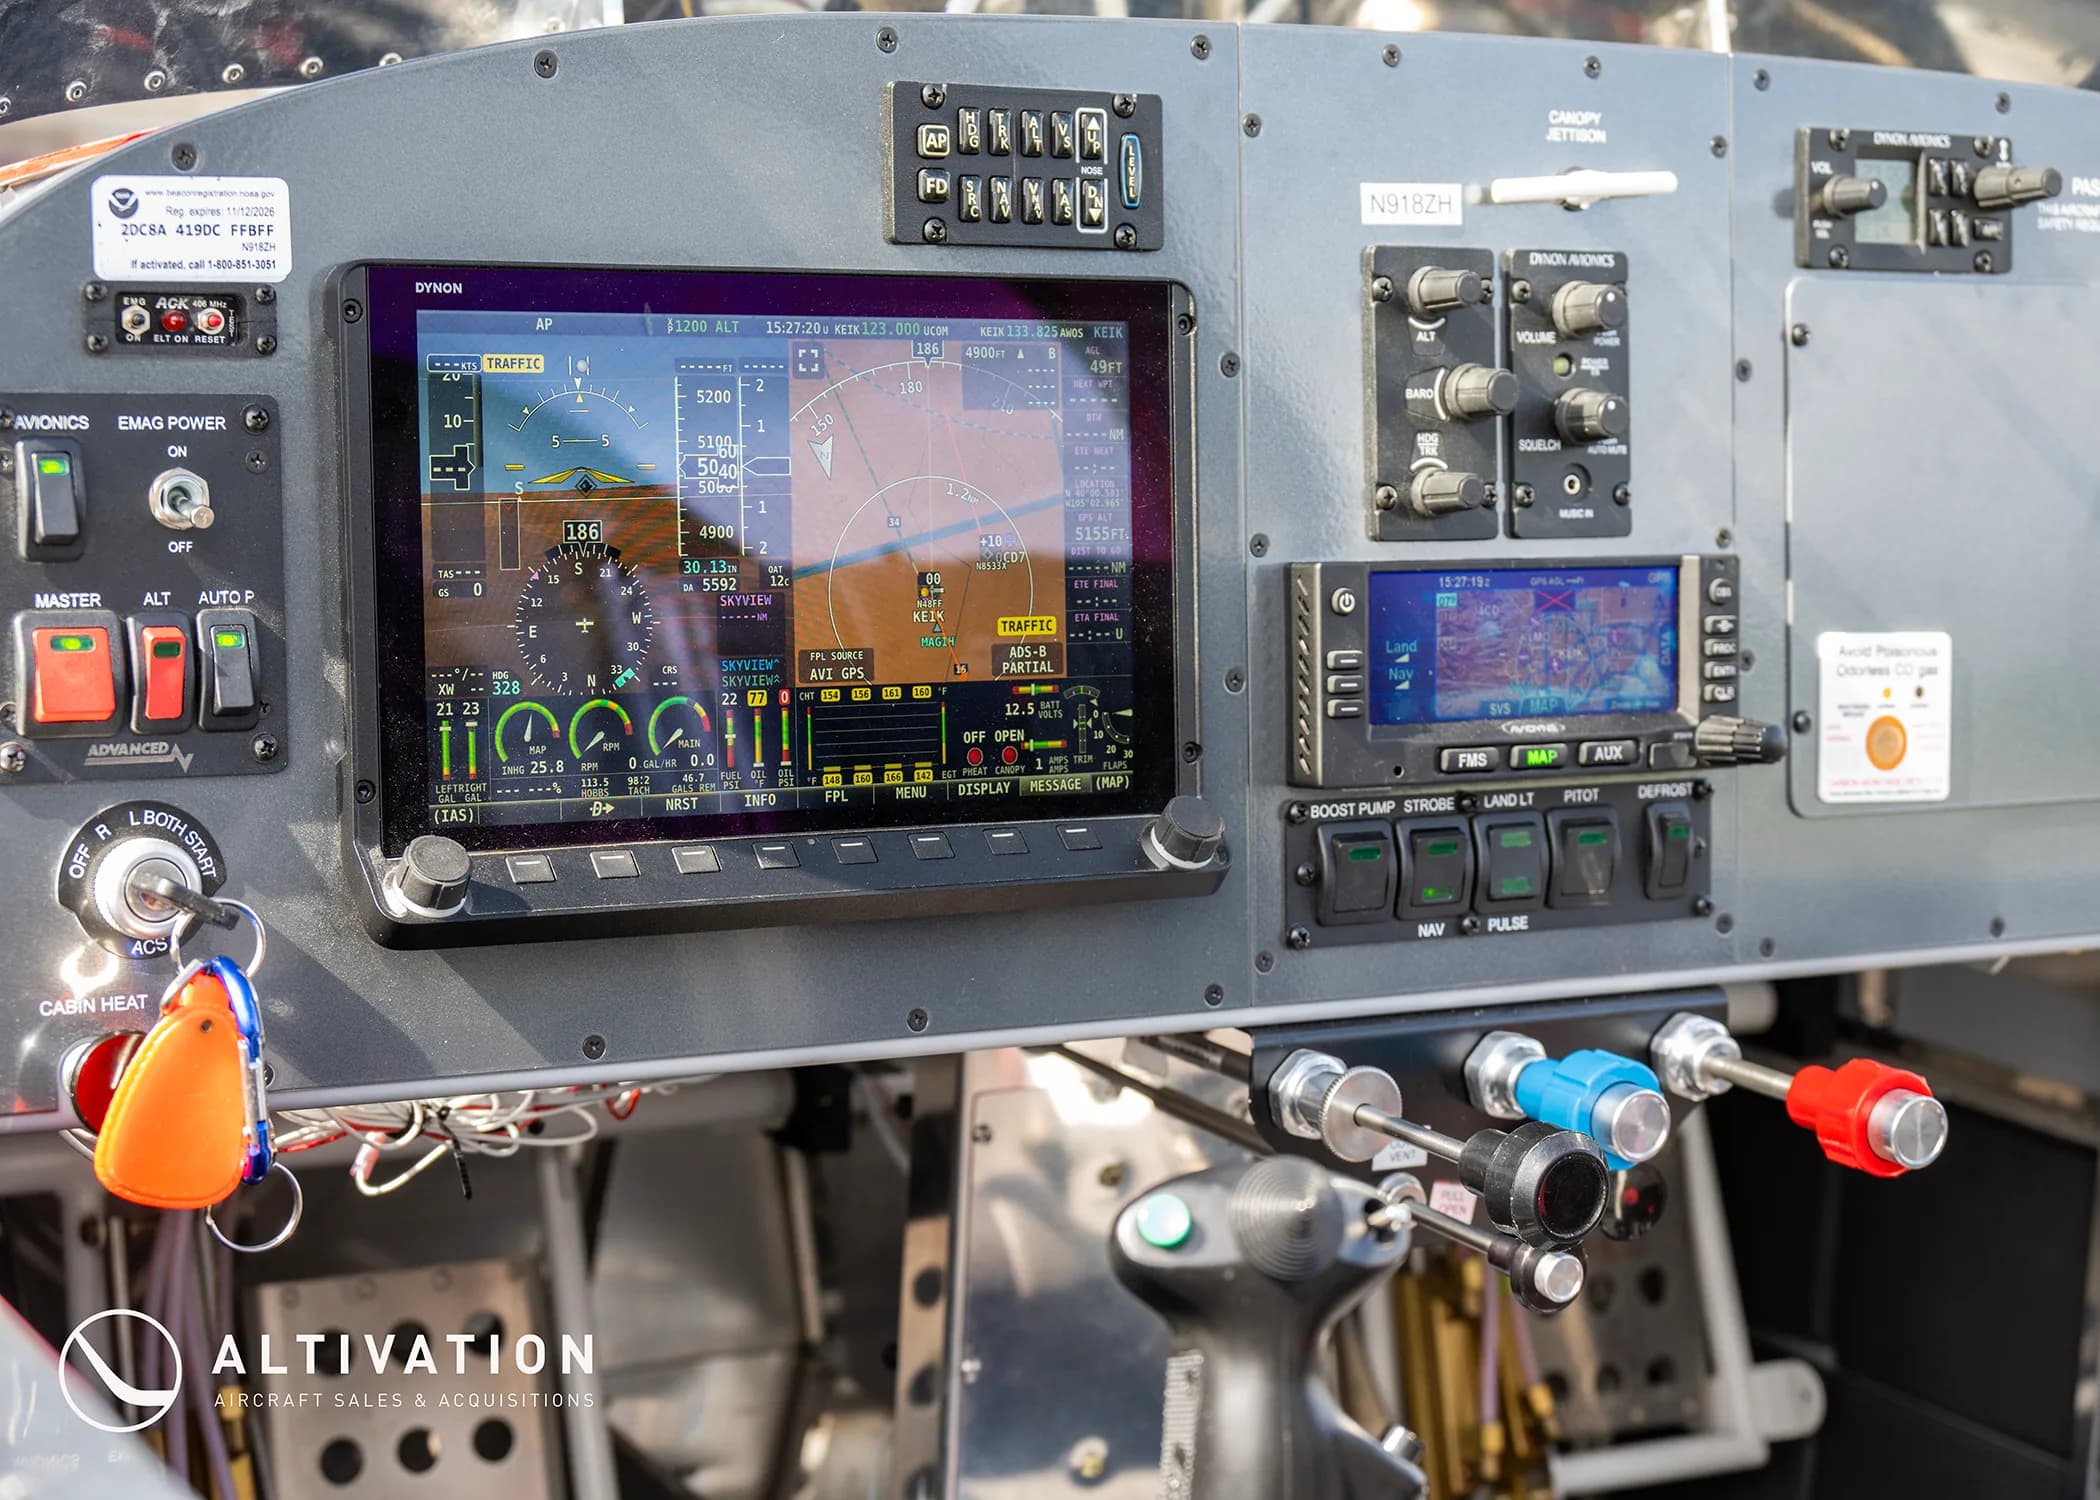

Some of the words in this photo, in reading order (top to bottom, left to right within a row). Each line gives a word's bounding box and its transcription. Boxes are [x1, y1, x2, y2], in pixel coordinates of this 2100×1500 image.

[1548, 109, 1602, 126] CANOPY
[965, 112, 979, 149] HDG
[996, 112, 1010, 150] TRK
[1030, 116, 1043, 152] ALT
[1545, 126, 1607, 144] JETTISON
[925, 135, 947, 149] AP
[1081, 165, 1104, 176] NOSE
[1127, 144, 1137, 199] LEVEL
[926, 180, 948, 194] FD
[966, 180, 980, 218] SRC
[997, 182, 1012, 217] NAV
[1370, 193, 1452, 215] N918ZH
[226, 206, 275, 217] 11/12/2026
[121, 223, 167, 236] 2DC8A
[176, 224, 221, 236] 419DC
[231, 224, 275, 237] FFBFF
[242, 242, 276, 252] N918ZH
[140, 259, 186, 271] activated,
[188, 259, 205, 270] call
[207, 259, 276, 270] 1-800-851-3051
[1529, 252, 1567, 267] DYNON
[1567, 253, 1615, 268] AVIONICS
[415, 282, 463, 294] DYNON
[155, 296, 190, 310] ACK
[675, 319, 708, 333] 1200
[715, 320, 740, 333] ALT
[861, 321, 920, 336] 123.000
[980, 326, 1005, 337] KEIK
[1006, 325, 1059, 338] 133.825
[1059, 327, 1084, 338] AWOS
[1094, 326, 1124, 339] KEIK
[153, 334, 171, 343] ELT
[173, 334, 189, 343] ON
[194, 334, 226, 344] RESET
[1416, 331, 1436, 343] ALT
[1516, 331, 1556, 344] VOLUME
[916, 342, 939, 356] 186
[486, 357, 541, 370] TRAFFIC
[899, 380, 923, 395] 180
[1405, 389, 1434, 400] BARO
[696, 389, 731, 404] 5200
[14, 414, 90, 431] AVIONICS
[118, 415, 164, 431] EMAG
[168, 415, 227, 431] POWER
[810, 413, 834, 437] 150
[1417, 433, 1438, 444] HDG
[1518, 439, 1562, 451] SQUELCH
[167, 445, 188, 458] ON
[1419, 445, 1438, 457] TRK
[566, 523, 600, 541] 186
[699, 525, 734, 539] 4900
[168, 541, 194, 553] OFF
[767, 565, 783, 574] OAT
[702, 577, 737, 592] 5592
[1093, 579, 1119, 588] FINAL
[35, 592, 102, 609] MASTER
[143, 591, 171, 606] ALT
[198, 590, 242, 605] AUTO
[244, 589, 255, 604] P
[719, 594, 772, 607] SKYVIEW
[1075, 613, 1090, 622] ETA
[1094, 612, 1120, 622] FINAL
[1001, 619, 1053, 632] TRAFFIC
[1009, 645, 1047, 659] ADS-B
[1385, 639, 1418, 654] Land
[810, 651, 826, 661] FPL
[831, 650, 864, 660] SOURCE
[662, 665, 678, 675] CRS
[809, 668, 833, 681] AVI
[841, 666, 865, 680] GPS
[1002, 660, 1054, 674] PARTIAL
[1388, 667, 1415, 681] Nav
[492, 671, 509, 680] HDG
[492, 680, 521, 696] 328
[799, 691, 816, 701] CHT
[1004, 702, 1035, 717] 12.5
[1040, 701, 1061, 710] BATT
[1488, 702, 1512, 716] SVS
[1529, 699, 1558, 714] MAP
[1037, 709, 1063, 719] VOLTS
[963, 730, 986, 744] OFF
[994, 729, 1025, 742] OPEN
[88, 741, 170, 758] ADVANCED
[528, 745, 547, 755] MAP
[602, 742, 620, 752] RPM
[678, 739, 701, 748] MAIN
[1073, 755, 1094, 764] TRIM
[1458, 752, 1489, 769] FMS
[1526, 749, 1558, 766] MAP
[1594, 745, 1623, 762] AUX
[502, 765, 525, 775] INHG
[530, 760, 565, 774] 25.8
[580, 762, 599, 772] RPM
[643, 758, 678, 769] GAL/HR
[690, 753, 715, 767] 0.0
[1103, 760, 1128, 771] FLAPS
[720, 771, 742, 781] FUEL
[750, 770, 767, 779] OIL
[778, 769, 795, 778] OIL
[941, 770, 957, 779] EGT
[962, 766, 989, 777] PHEAT
[994, 765, 1026, 775] CANOPY
[581, 777, 610, 788] 113.5
[682, 773, 705, 783] 46.7
[778, 778, 795, 787] PSI
[1030, 777, 1082, 793] MESSAGE
[1095, 774, 1130, 791] (MAP)
[627, 786, 650, 796] TACH
[671, 784, 694, 794] GALS
[699, 782, 716, 792] REM
[723, 781, 740, 790] PSI
[895, 785, 927, 800] MENU
[958, 781, 1011, 797] DISPLAY
[1638, 782, 1693, 800] DEFROST
[581, 788, 610, 798] HOBBS
[744, 793, 777, 807] INFO
[824, 790, 849, 803] FPL
[1563, 788, 1600, 804] PITOT
[665, 797, 699, 812] NRST
[1404, 797, 1455, 814] STROBE
[1484, 793, 1516, 809] LAND
[1517, 792, 1535, 807] LT
[433, 807, 474, 825] (IAS)
[1310, 803, 1356, 820] BOOST
[1358, 800, 1396, 816] PUMP
[129, 810, 141, 827] L
[143, 809, 187, 838] BOTH
[94, 823, 112, 841] R
[184, 829, 217, 879] START
[68, 843, 92, 880] OFF
[1418, 922, 1445, 939] NAV
[1487, 915, 1529, 933] PULSE
[39, 999, 97, 1017] CABIN
[101, 994, 149, 1012] HEAT
